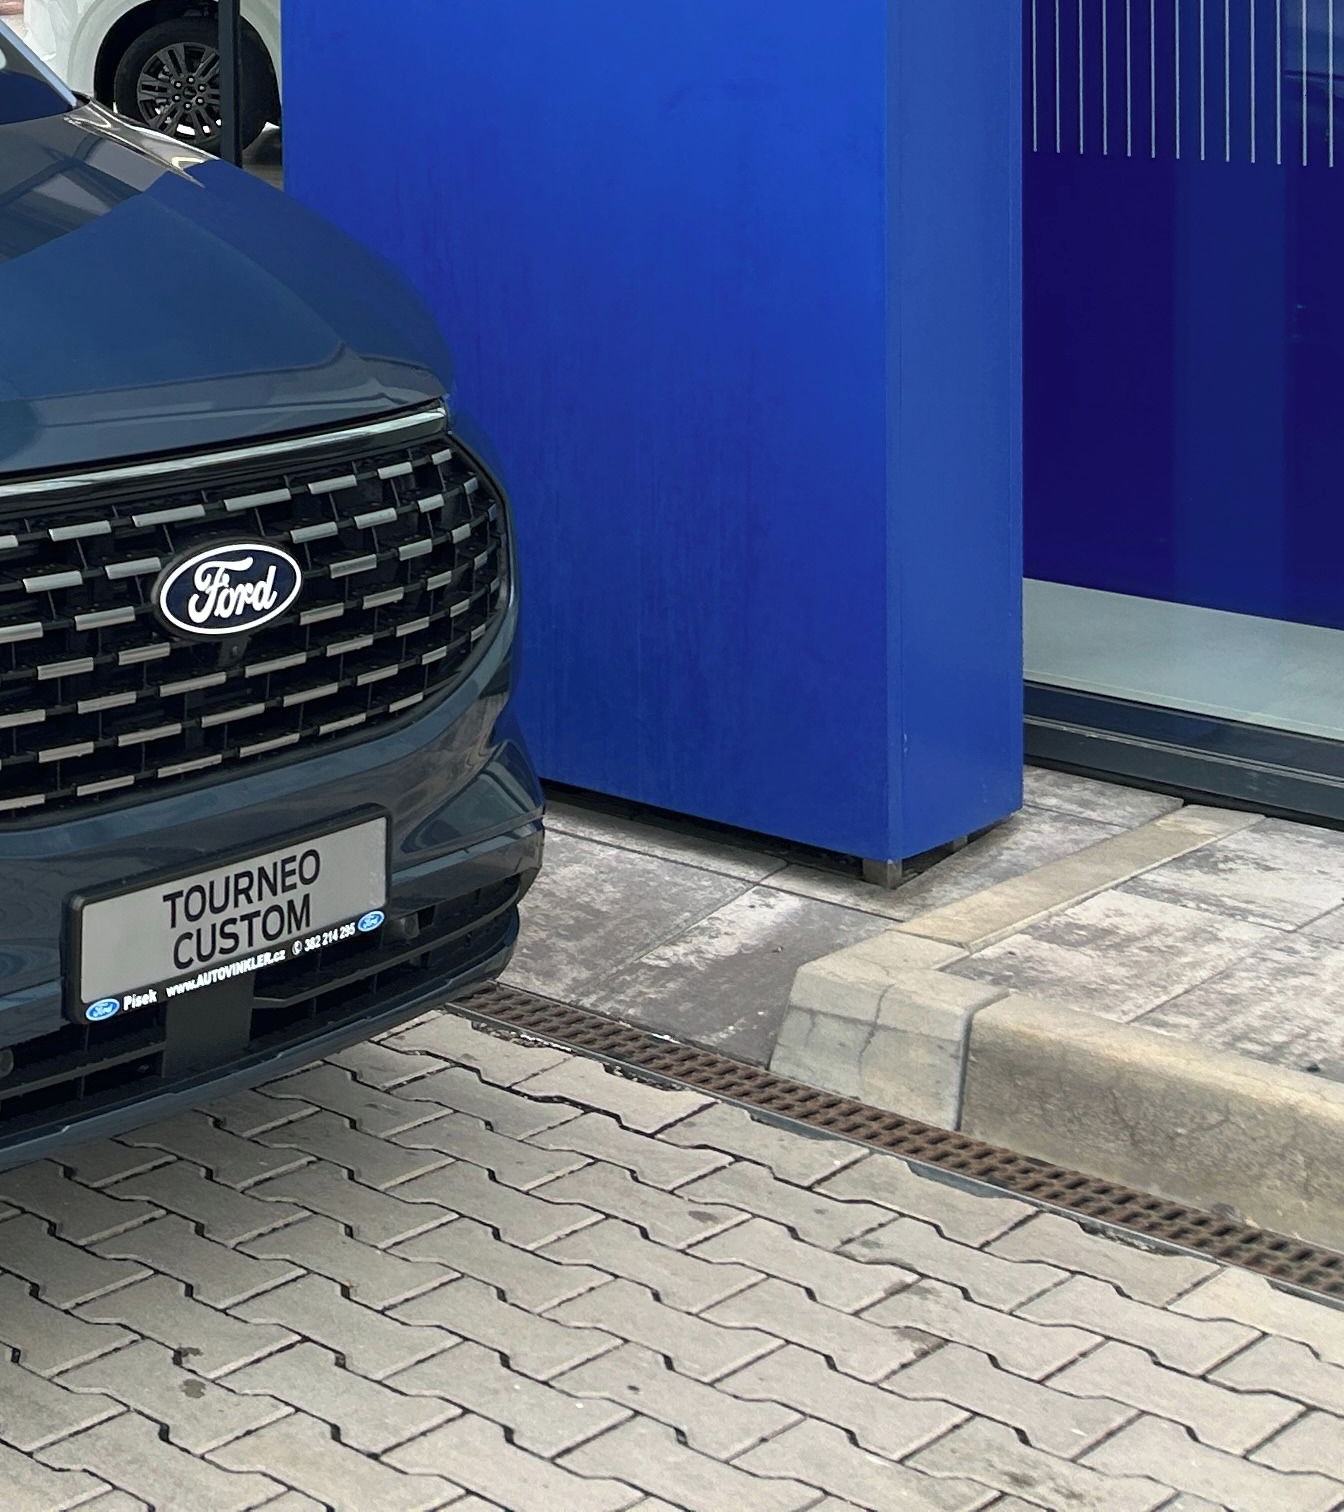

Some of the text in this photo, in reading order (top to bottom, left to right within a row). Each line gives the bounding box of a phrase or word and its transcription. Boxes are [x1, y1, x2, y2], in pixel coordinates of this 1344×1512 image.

[188, 556, 278, 623] Ford
[163, 849, 321, 928] TOURNEO
[173, 893, 311, 970] CUSTOM
[166, 950, 286, 997] www.AUTOVINKLER.cz
